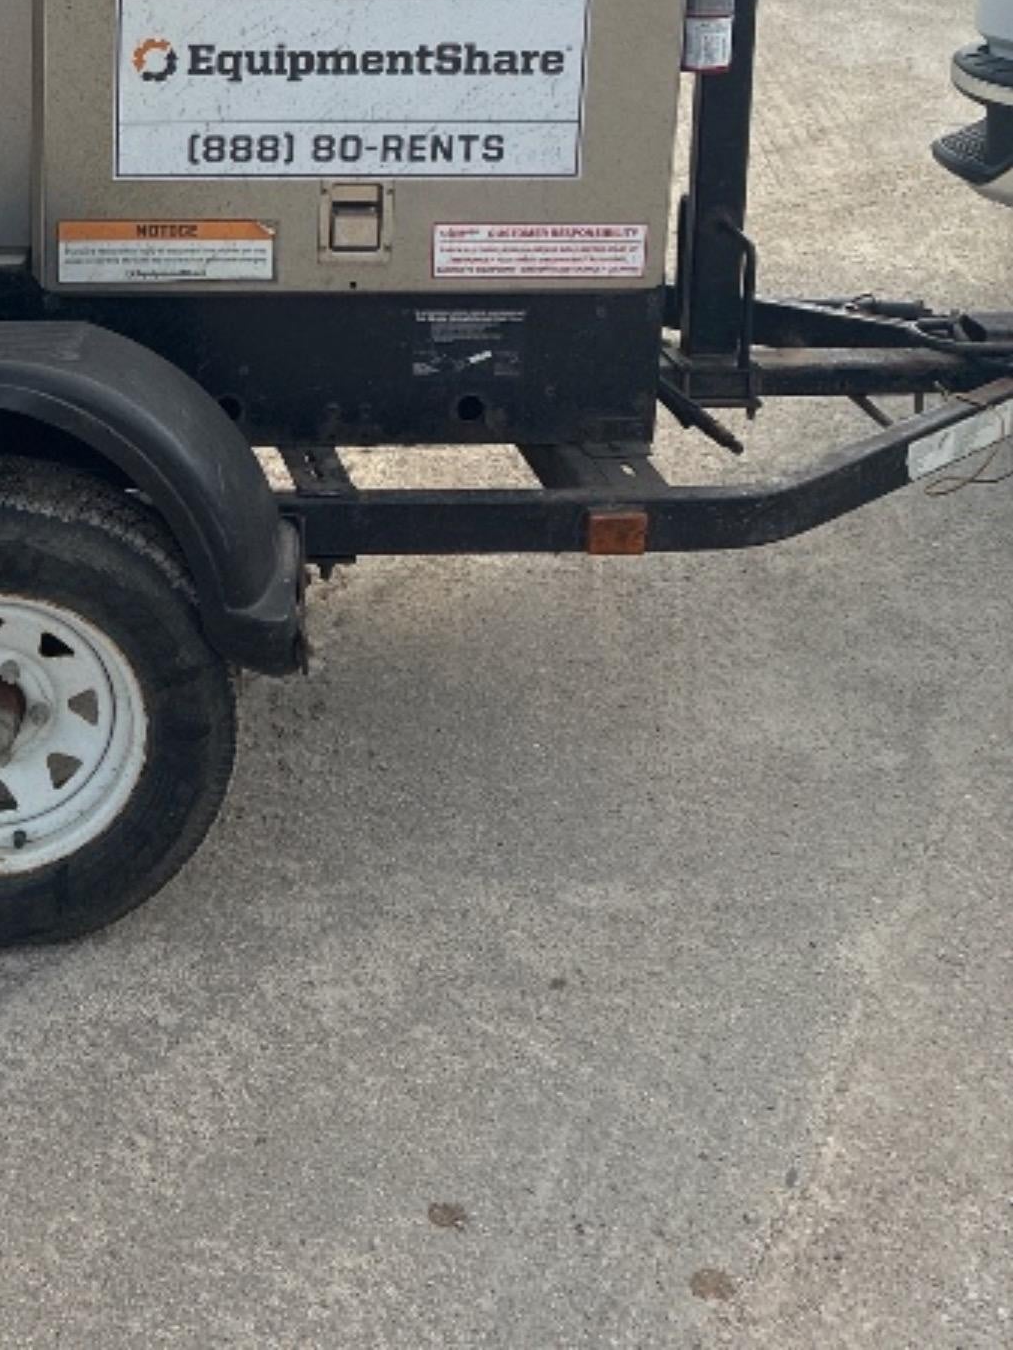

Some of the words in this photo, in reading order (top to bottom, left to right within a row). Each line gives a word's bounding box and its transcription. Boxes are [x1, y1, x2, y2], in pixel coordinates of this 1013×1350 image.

[187, 44, 565, 81] EquipmentShare
[188, 133, 295, 165] (888)
[311, 134, 505, 163] 80-RENTS
[136, 225, 198, 238] NOTICE
